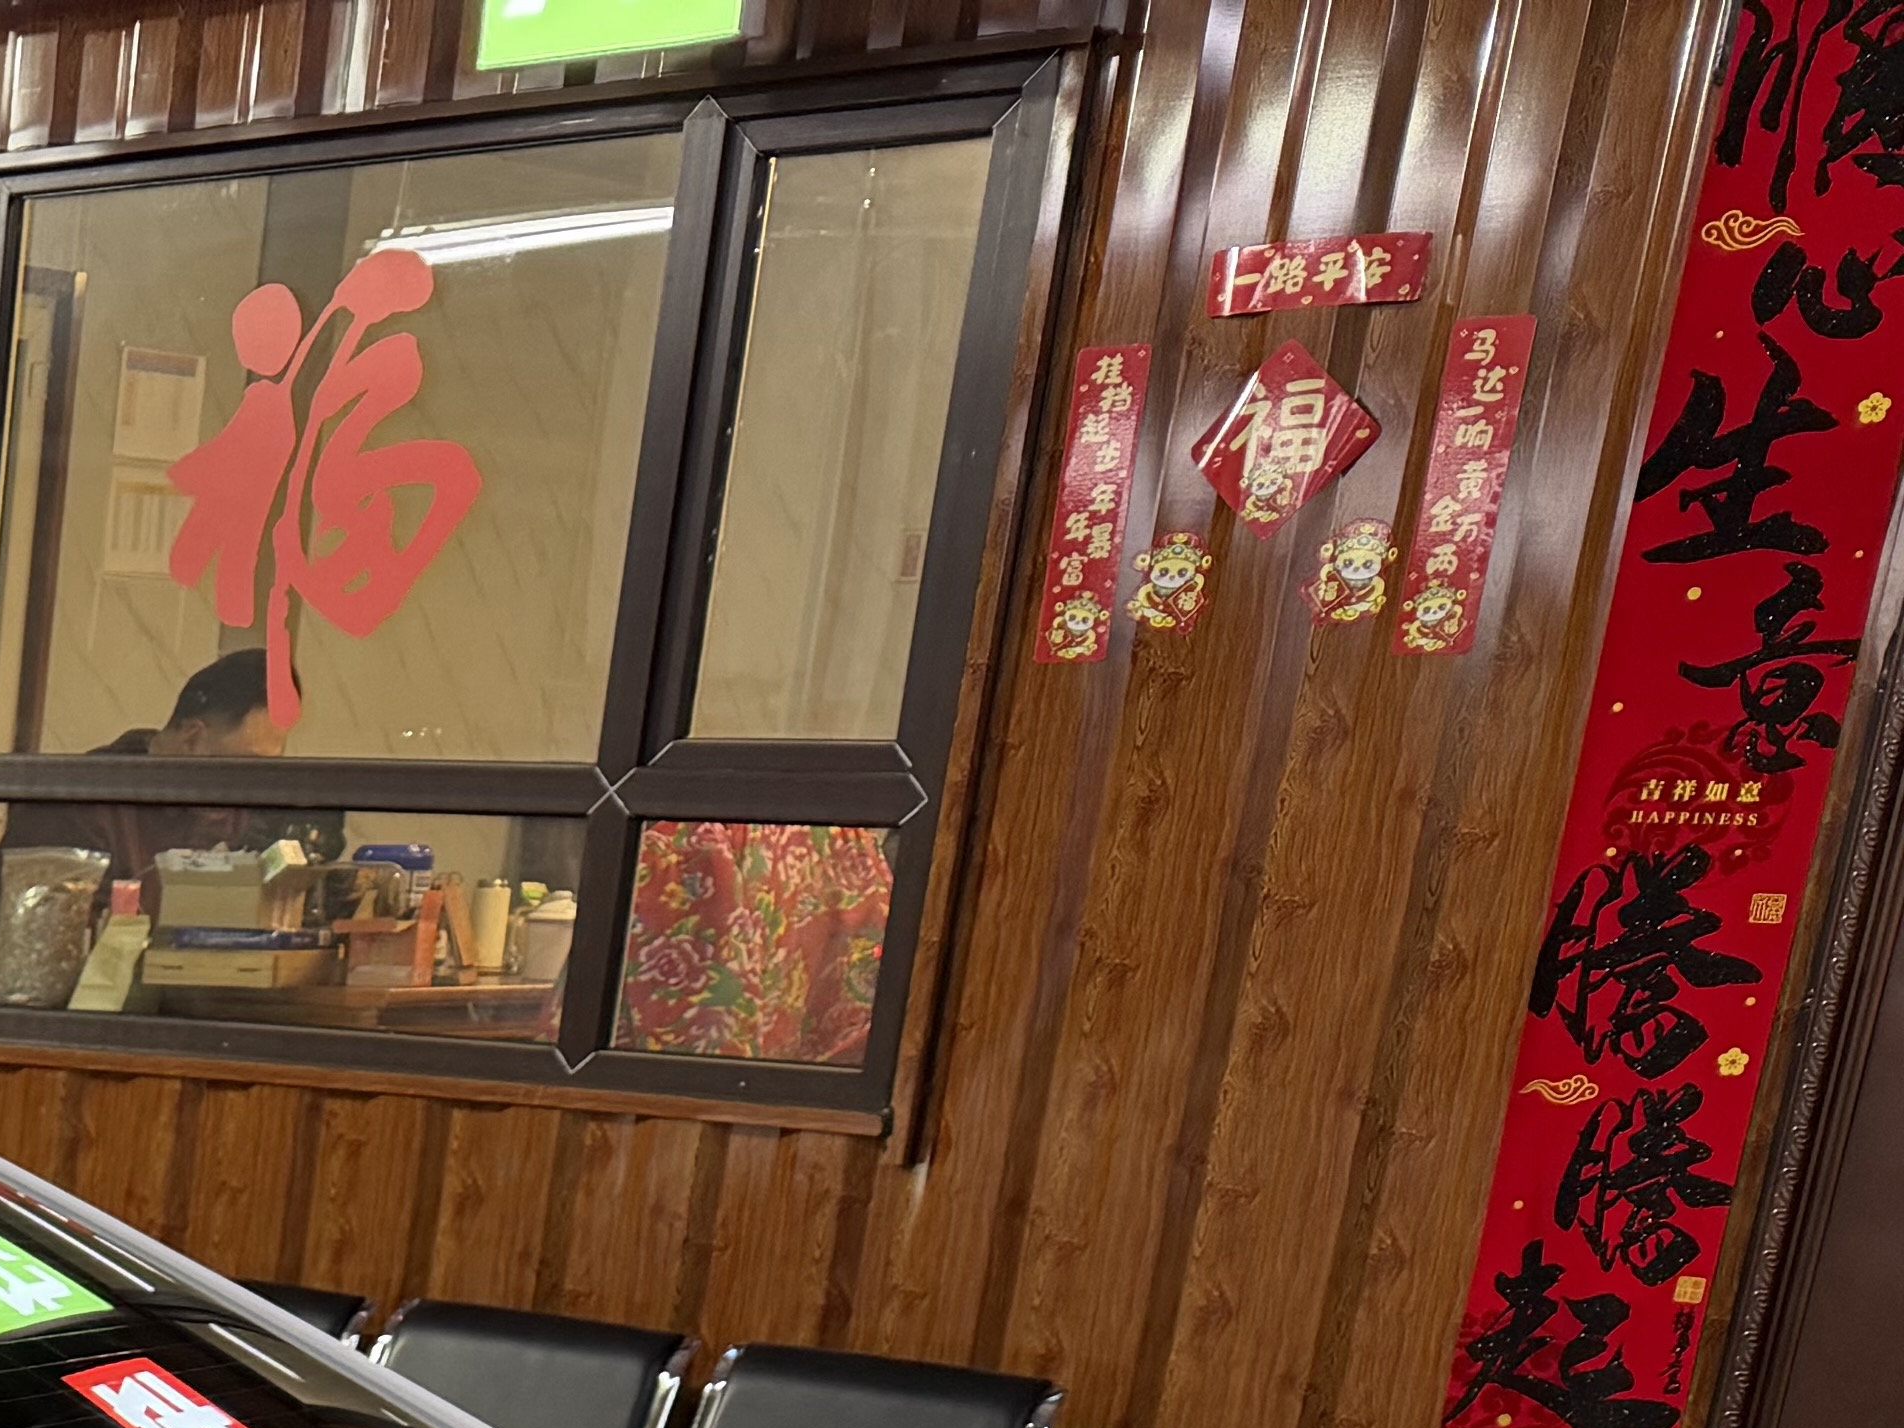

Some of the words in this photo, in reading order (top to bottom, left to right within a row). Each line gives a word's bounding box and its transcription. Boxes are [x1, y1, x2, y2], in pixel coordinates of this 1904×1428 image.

[1232, 244, 1392, 297] 一路平安
[1229, 376, 1328, 474] 福
[165, 249, 483, 731] 福
[1639, 778, 1763, 804] 吉祥如意
[1628, 810, 1759, 827] HAPPINESS
